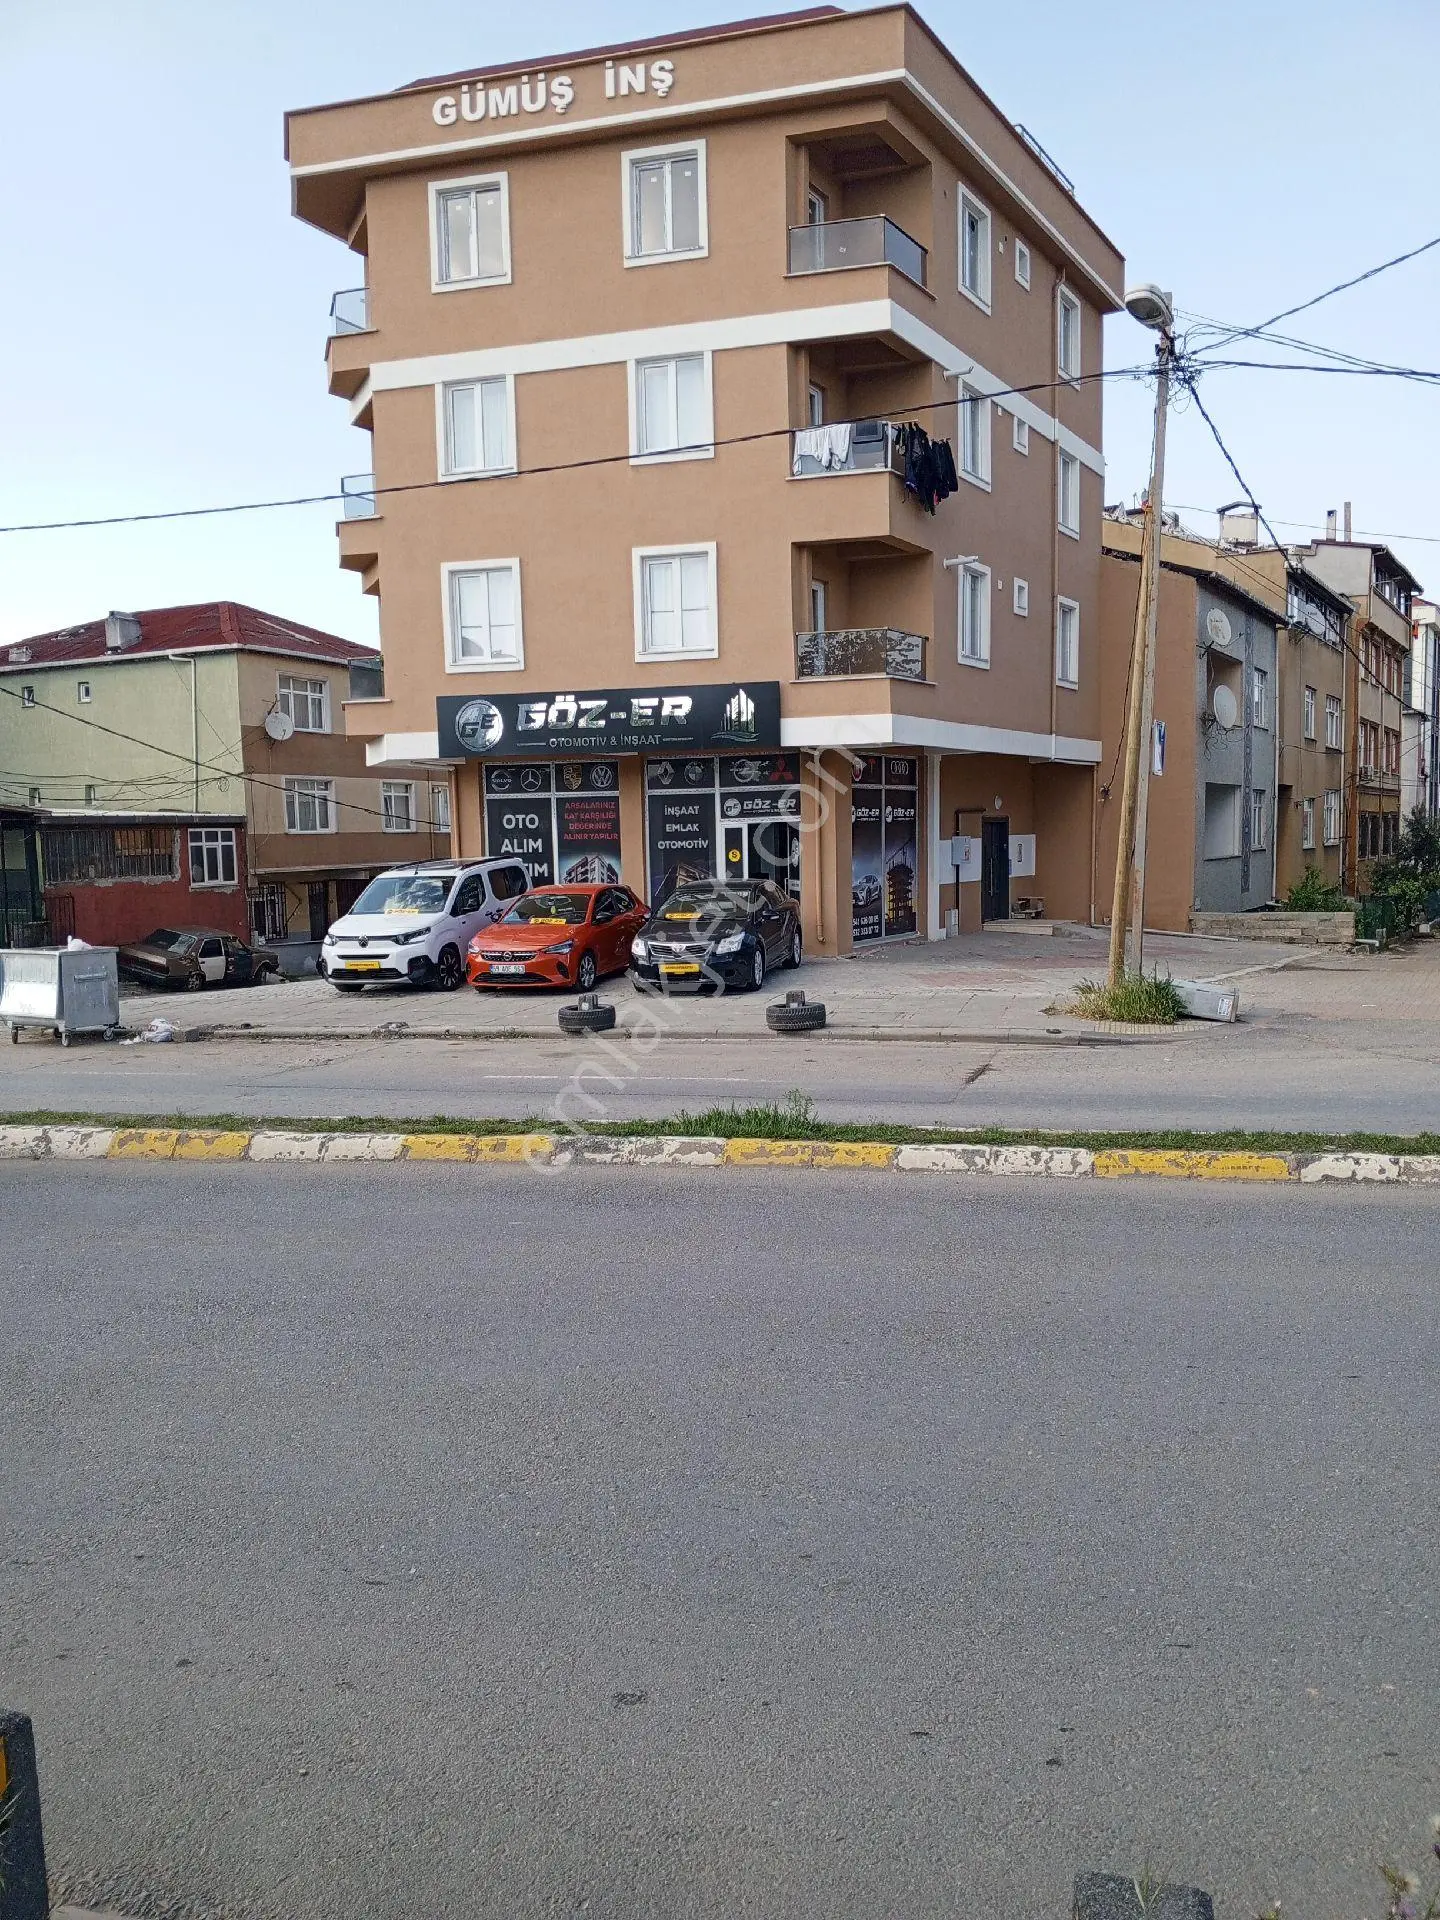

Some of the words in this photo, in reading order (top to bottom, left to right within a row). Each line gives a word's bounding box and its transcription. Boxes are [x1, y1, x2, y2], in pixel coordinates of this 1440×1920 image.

[432, 73, 575, 126] GÜMÜŞ
[605, 60, 675, 98] İNŞ
[517, 694, 693, 731] GÖZ-ER
[549, 736, 607, 748] OTOMOTİV
[610, 735, 618, 746] &
[621, 733, 662, 746] İNŞAAT
[664, 804, 700, 818] İNŞAAT
[743, 798, 797, 811] GÖZ-ER
[503, 813, 539, 829] OTO
[666, 823, 700, 832] EMLAK
[501, 838, 543, 853] ALIM
[657, 837, 709, 850] OTOMOTİV
